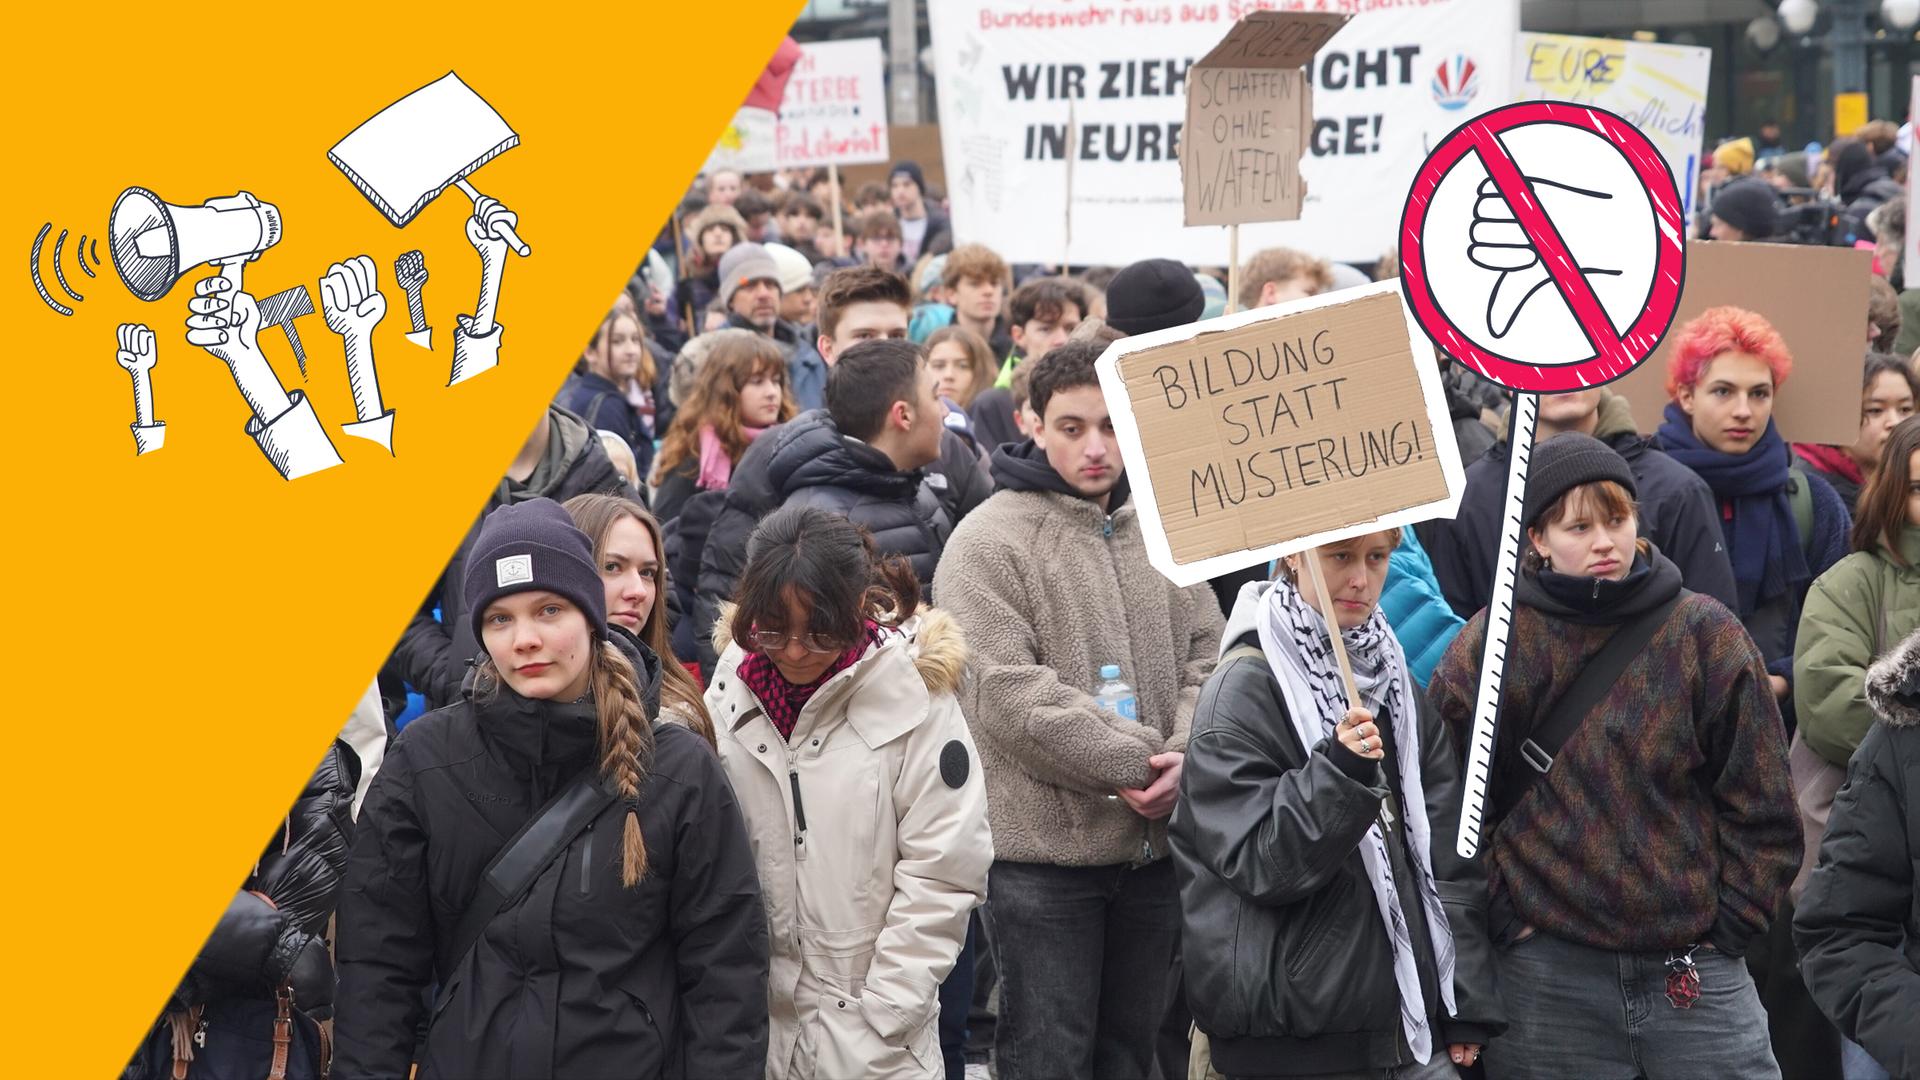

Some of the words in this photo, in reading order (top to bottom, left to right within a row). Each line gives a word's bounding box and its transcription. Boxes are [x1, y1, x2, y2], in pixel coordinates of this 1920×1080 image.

[979, 4, 1114, 30] Bundeswehr
[1120, 6, 1172, 26] raus
[1180, 4, 1219, 23] aus
[1001, 64, 1086, 100] WIR
[1099, 58, 1194, 99] ZIEH
[1306, 46, 1421, 90] ICHT
[1526, 43, 1627, 83] EURE
[1200, 69, 1292, 110] SCHAFFEN
[1025, 123, 1068, 161] IN
[1212, 110, 1273, 143] OHNE
[1195, 148, 1292, 213] WAFFEN!
[1153, 330, 1335, 410] BILDUNG
[1223, 377, 1348, 445] STATT
[1190, 420, 1423, 517] MUSTERUNG!
